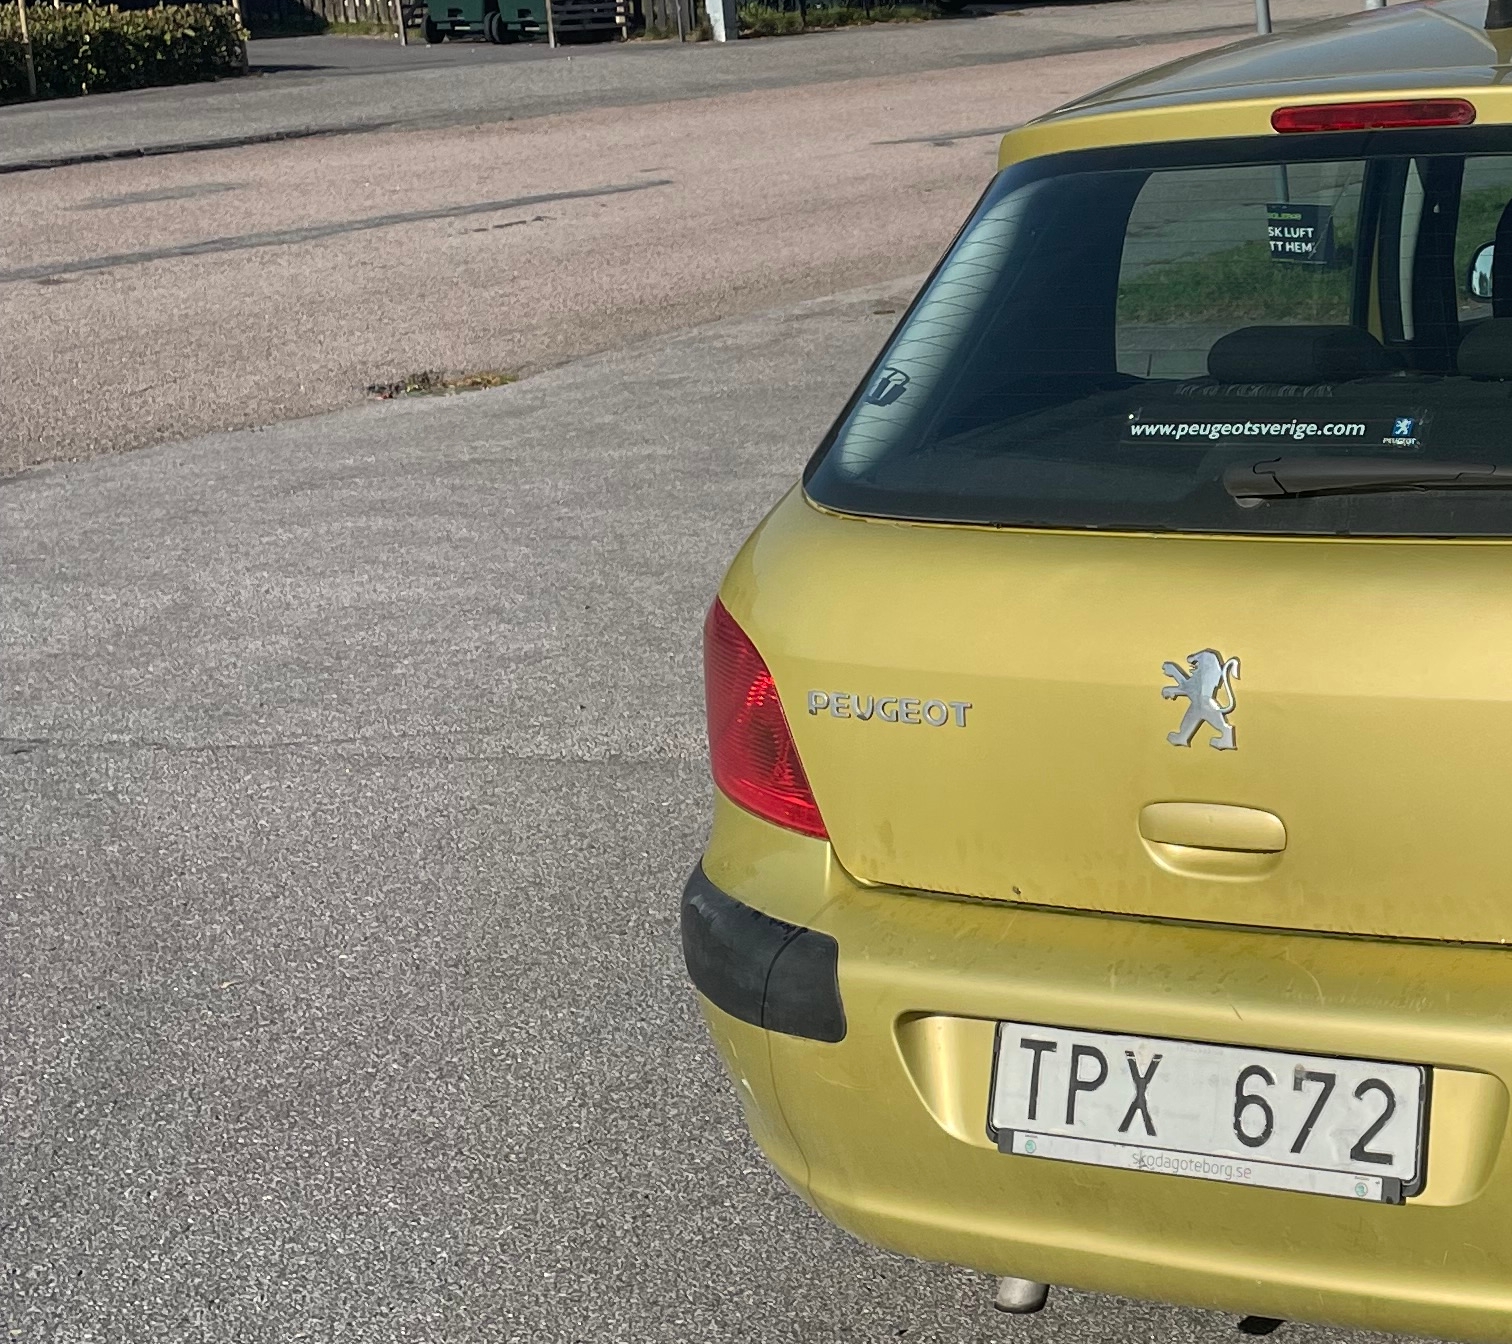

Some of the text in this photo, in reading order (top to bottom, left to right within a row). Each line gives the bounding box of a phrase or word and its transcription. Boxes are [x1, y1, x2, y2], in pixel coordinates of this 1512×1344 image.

[1284, 227, 1314, 238] LUFT
[1130, 419, 1366, 439] www.peugeotsverige.com
[808, 690, 972, 728] PEUGEOT
[1020, 1038, 1396, 1166] TPX 672
[1132, 1150, 1252, 1181] skodagoteborg.se
